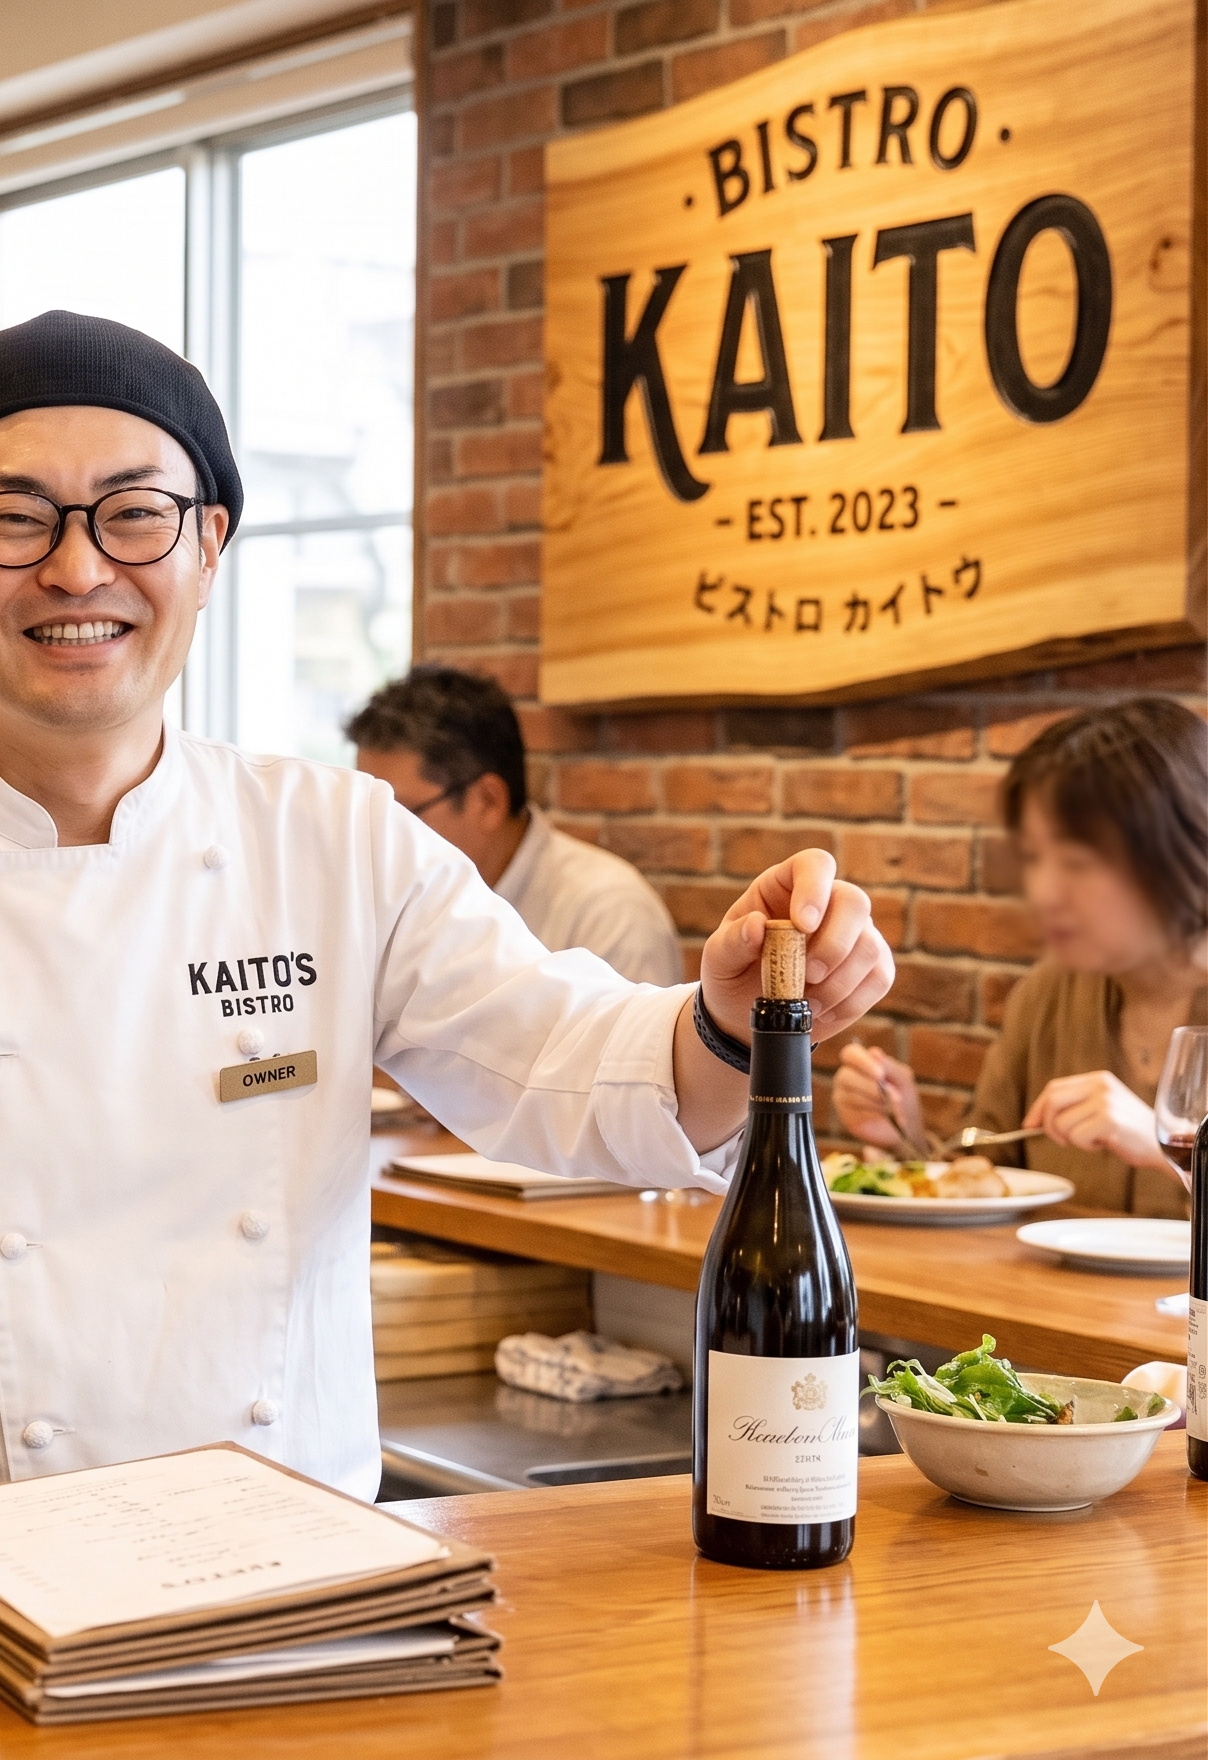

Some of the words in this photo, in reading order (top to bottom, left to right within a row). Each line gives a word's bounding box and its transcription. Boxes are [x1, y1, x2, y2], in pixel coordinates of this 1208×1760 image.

[704, 83, 979, 219] BISTRO
[593, 191, 1115, 504] KAITO
[745, 494, 817, 544] EST.
[828, 484, 920, 536] 2023
[843, 554, 983, 633] カイトウ
[187, 951, 318, 996] KAITO'S
[220, 993, 295, 1018] BISTRO
[242, 1065, 296, 1087] OWNER
